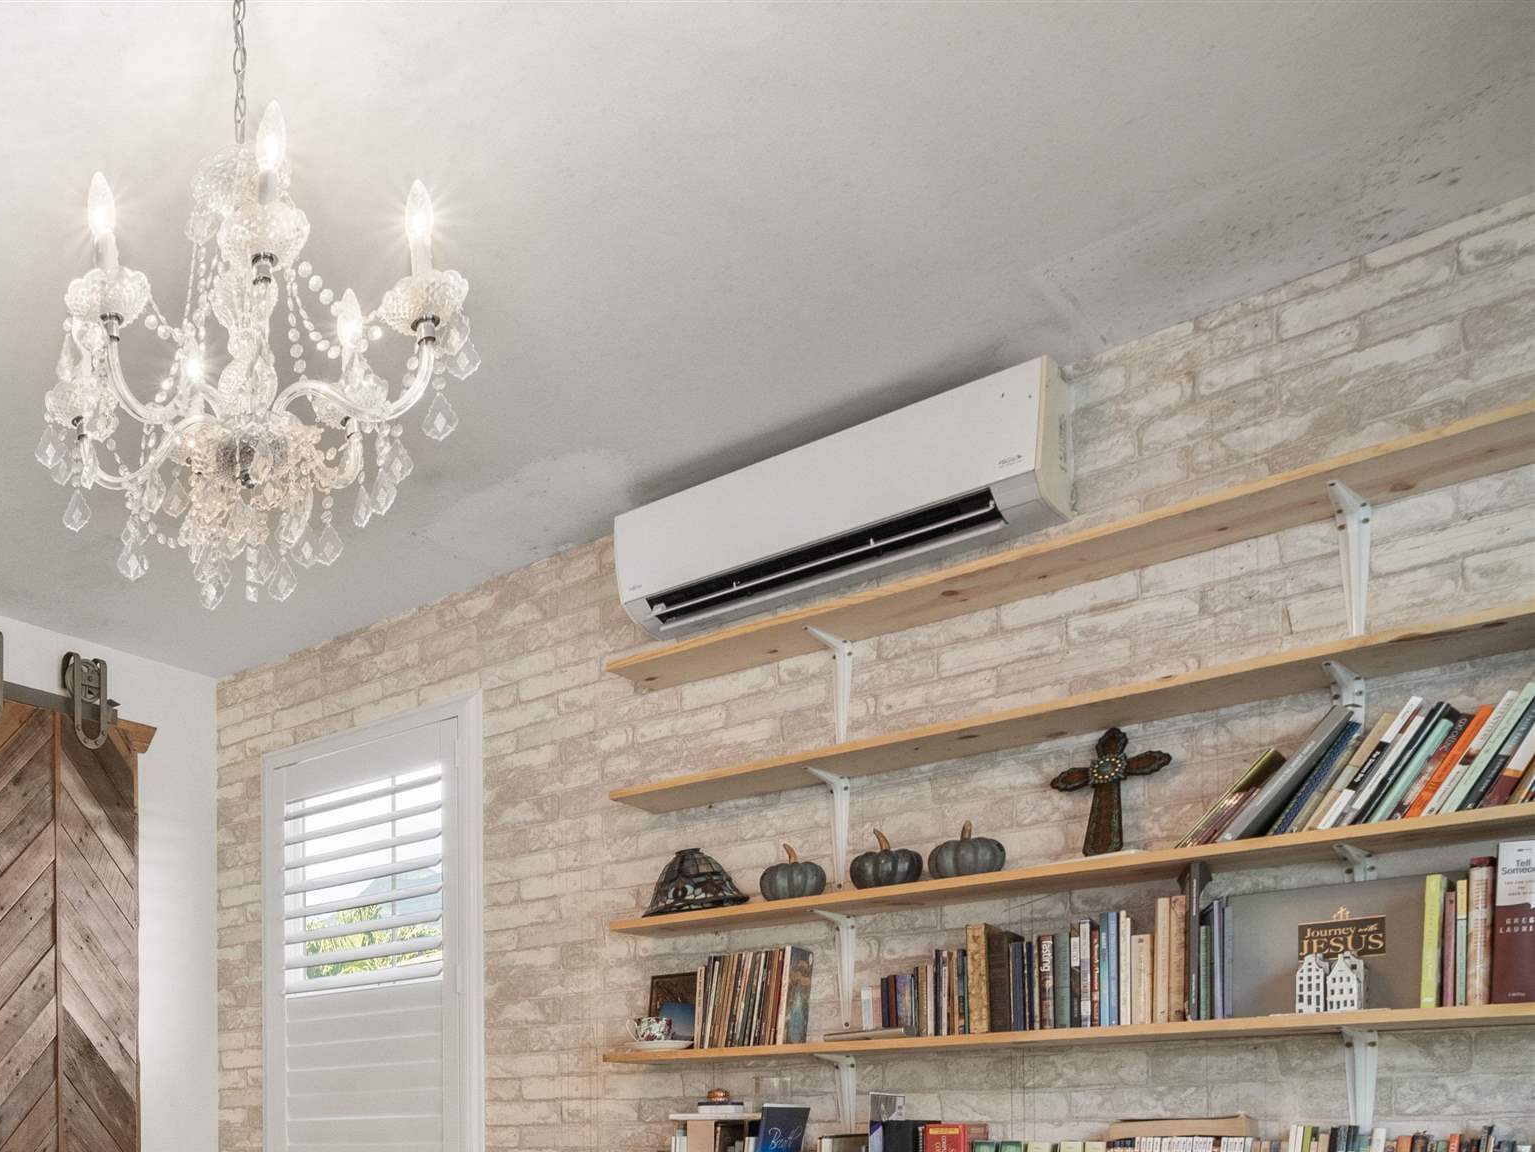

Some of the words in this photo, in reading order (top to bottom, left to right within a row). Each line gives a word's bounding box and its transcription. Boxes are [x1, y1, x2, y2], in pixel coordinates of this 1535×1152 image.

[1515, 858, 1531, 868] Tell
[1305, 926, 1356, 939] Journey
[1299, 933, 1384, 956] JESUS
[1039, 939, 1053, 971] fasting
